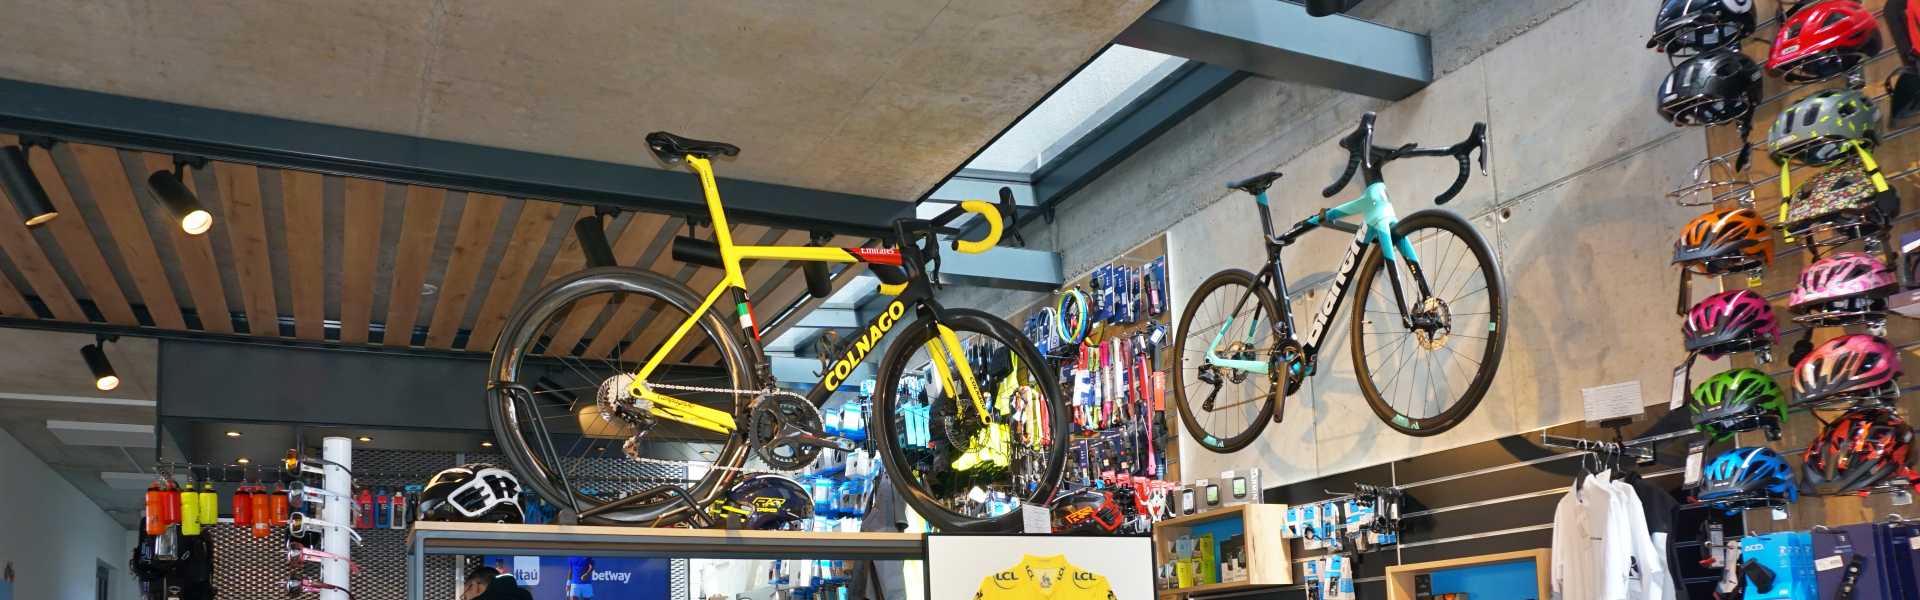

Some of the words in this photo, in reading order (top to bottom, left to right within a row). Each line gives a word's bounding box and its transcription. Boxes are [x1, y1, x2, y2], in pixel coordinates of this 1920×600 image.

[824, 300, 905, 392] COLNAGO
[592, 570, 632, 584] betway
[995, 571, 1019, 581] LCL
[1074, 571, 1096, 581] LCL
